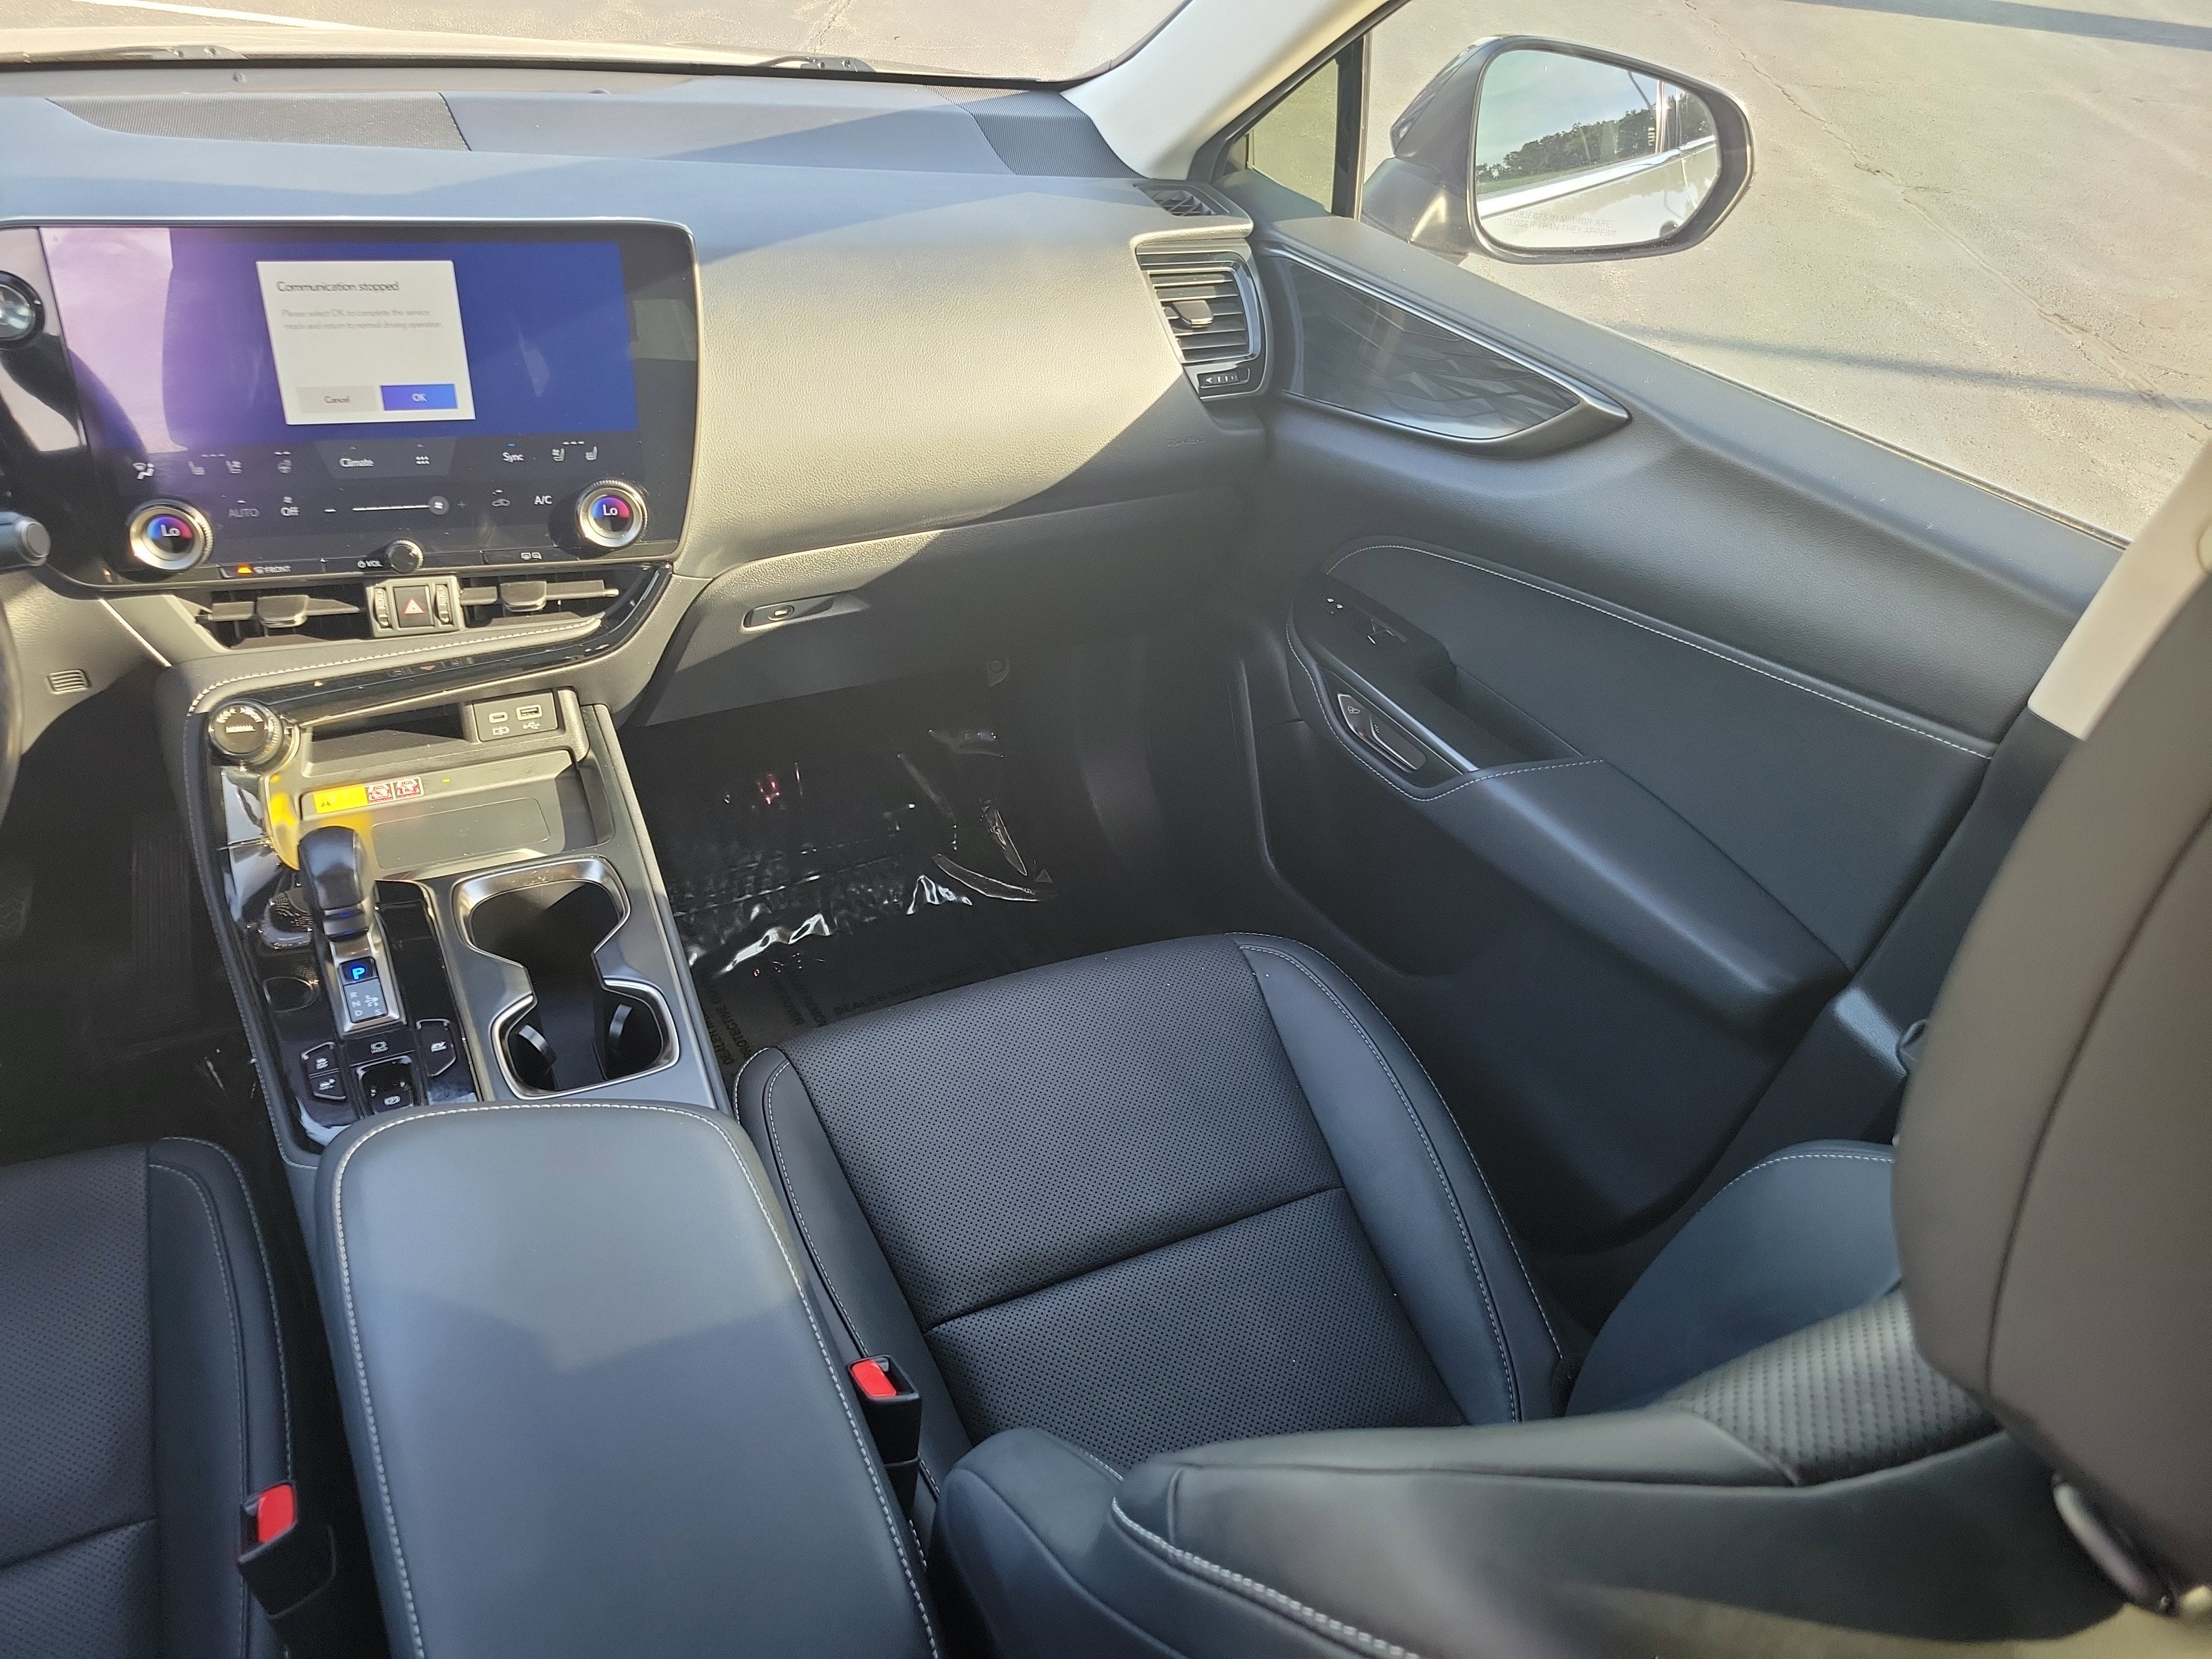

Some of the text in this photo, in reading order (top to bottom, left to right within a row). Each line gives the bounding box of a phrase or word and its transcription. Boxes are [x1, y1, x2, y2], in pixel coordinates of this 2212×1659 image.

[1513, 211, 1548, 221] OBJECTS
[1560, 216, 1593, 225] MIRROR
[1595, 219, 1612, 228] ARE
[1504, 218, 1617, 237] CLOSER THAN THEY APPEAR
[276, 280, 399, 294] Communication stopped
[331, 308, 346, 317] OK
[324, 395, 351, 404] Cancel
[411, 393, 428, 402] OK
[503, 452, 524, 462] Sync
[340, 458, 375, 467] Climate
[534, 495, 552, 505] A/C
[228, 508, 261, 518] AUTO
[280, 507, 300, 516] Off
[602, 504, 618, 516] Lo
[160, 524, 180, 537] Lo
[352, 967, 365, 980] P
